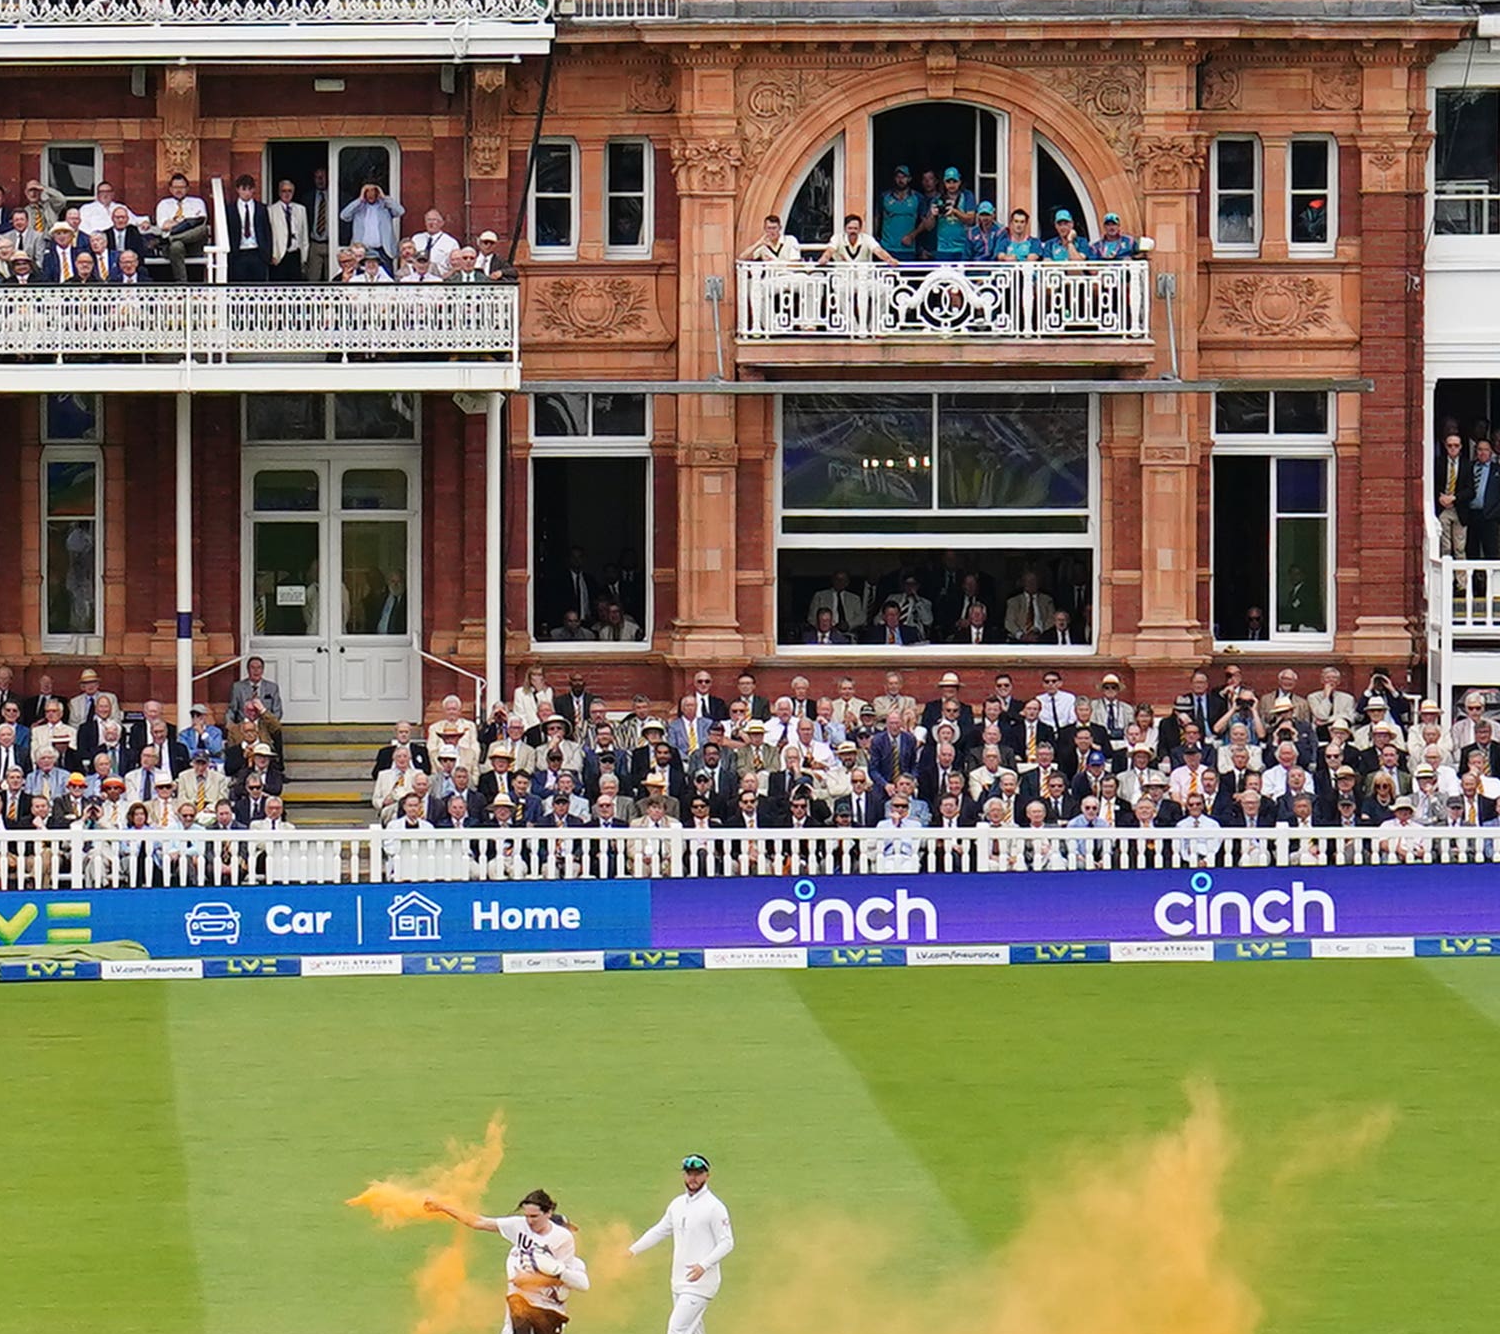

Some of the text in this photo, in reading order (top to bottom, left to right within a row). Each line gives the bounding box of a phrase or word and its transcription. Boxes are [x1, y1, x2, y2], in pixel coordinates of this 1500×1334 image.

[265, 904, 333, 935] Car
[472, 900, 581, 931] Home
[757, 879, 938, 944] cinch
[1154, 872, 1336, 937] cinch
